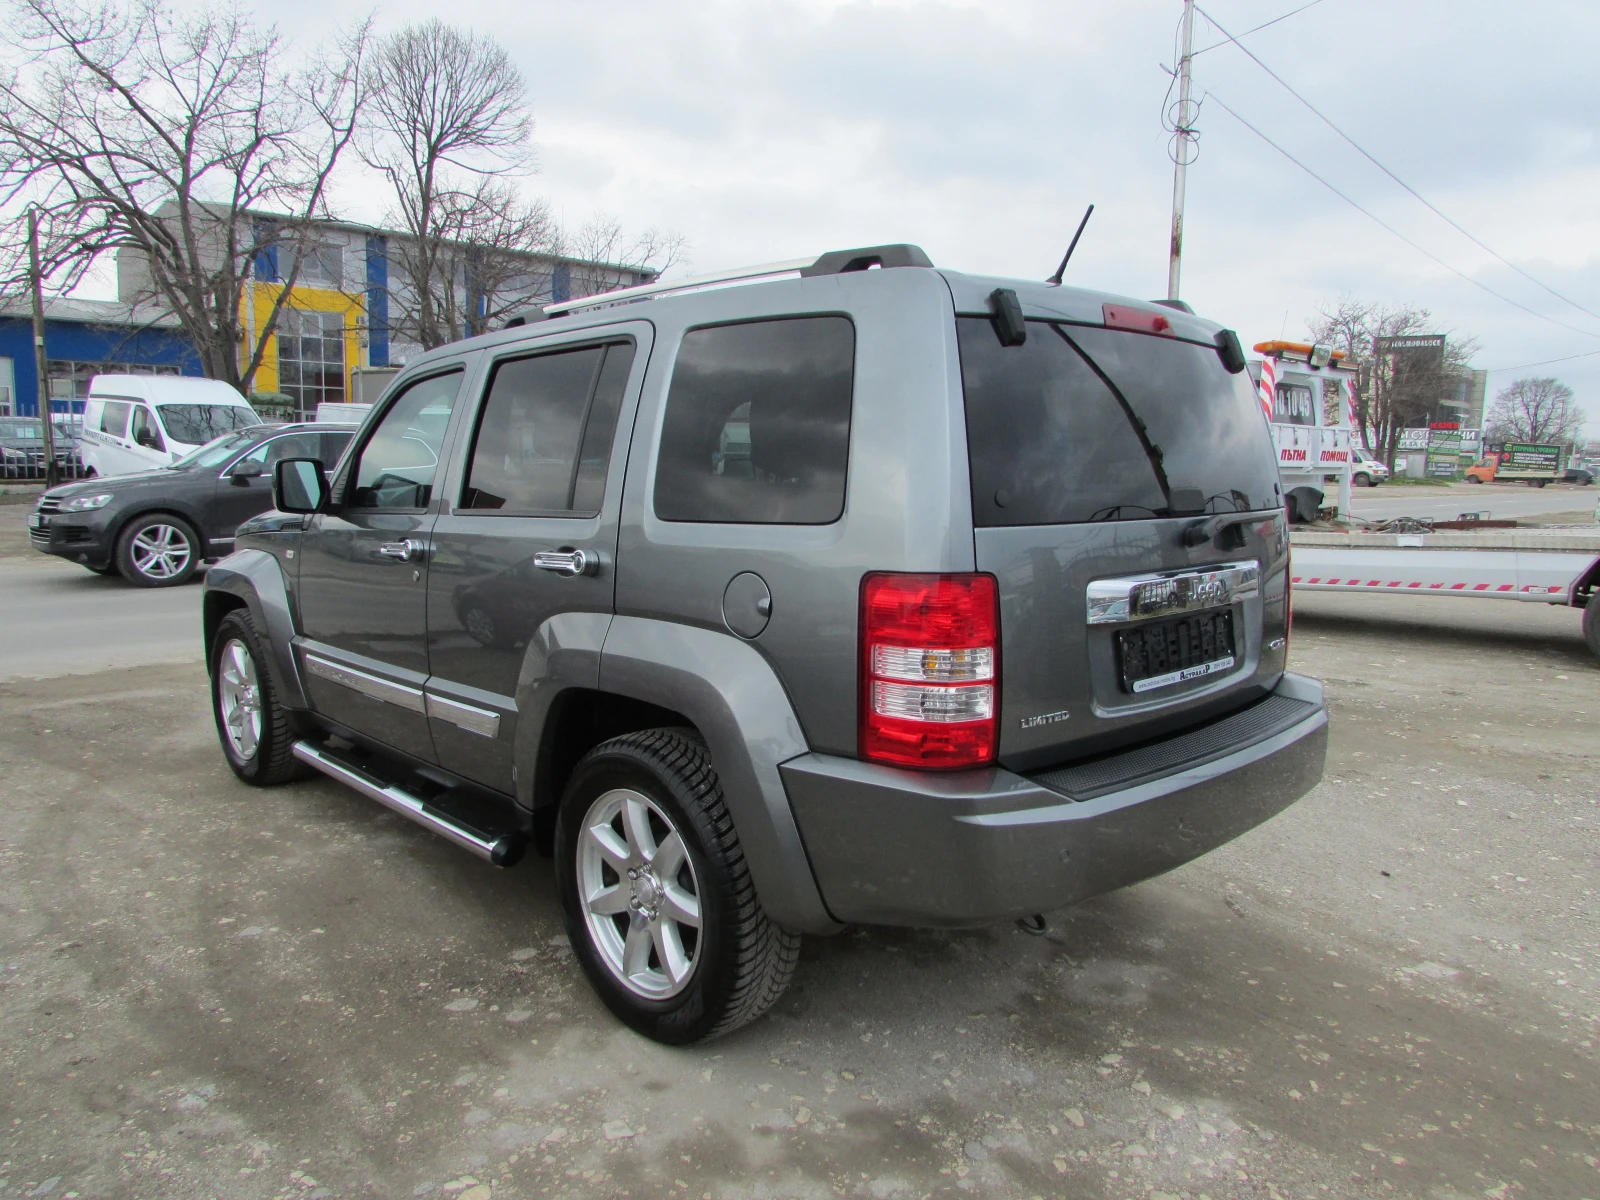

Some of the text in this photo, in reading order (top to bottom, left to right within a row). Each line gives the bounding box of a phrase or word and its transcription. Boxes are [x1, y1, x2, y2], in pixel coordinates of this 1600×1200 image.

[1287, 390, 1298, 417] 10
[1300, 392, 1310, 417] 45
[1281, 448, 1348, 463] ПЪТНА ПОМОЩ
[1188, 578, 1227, 605] Jeep
[1020, 710, 1070, 729] LIMITED
